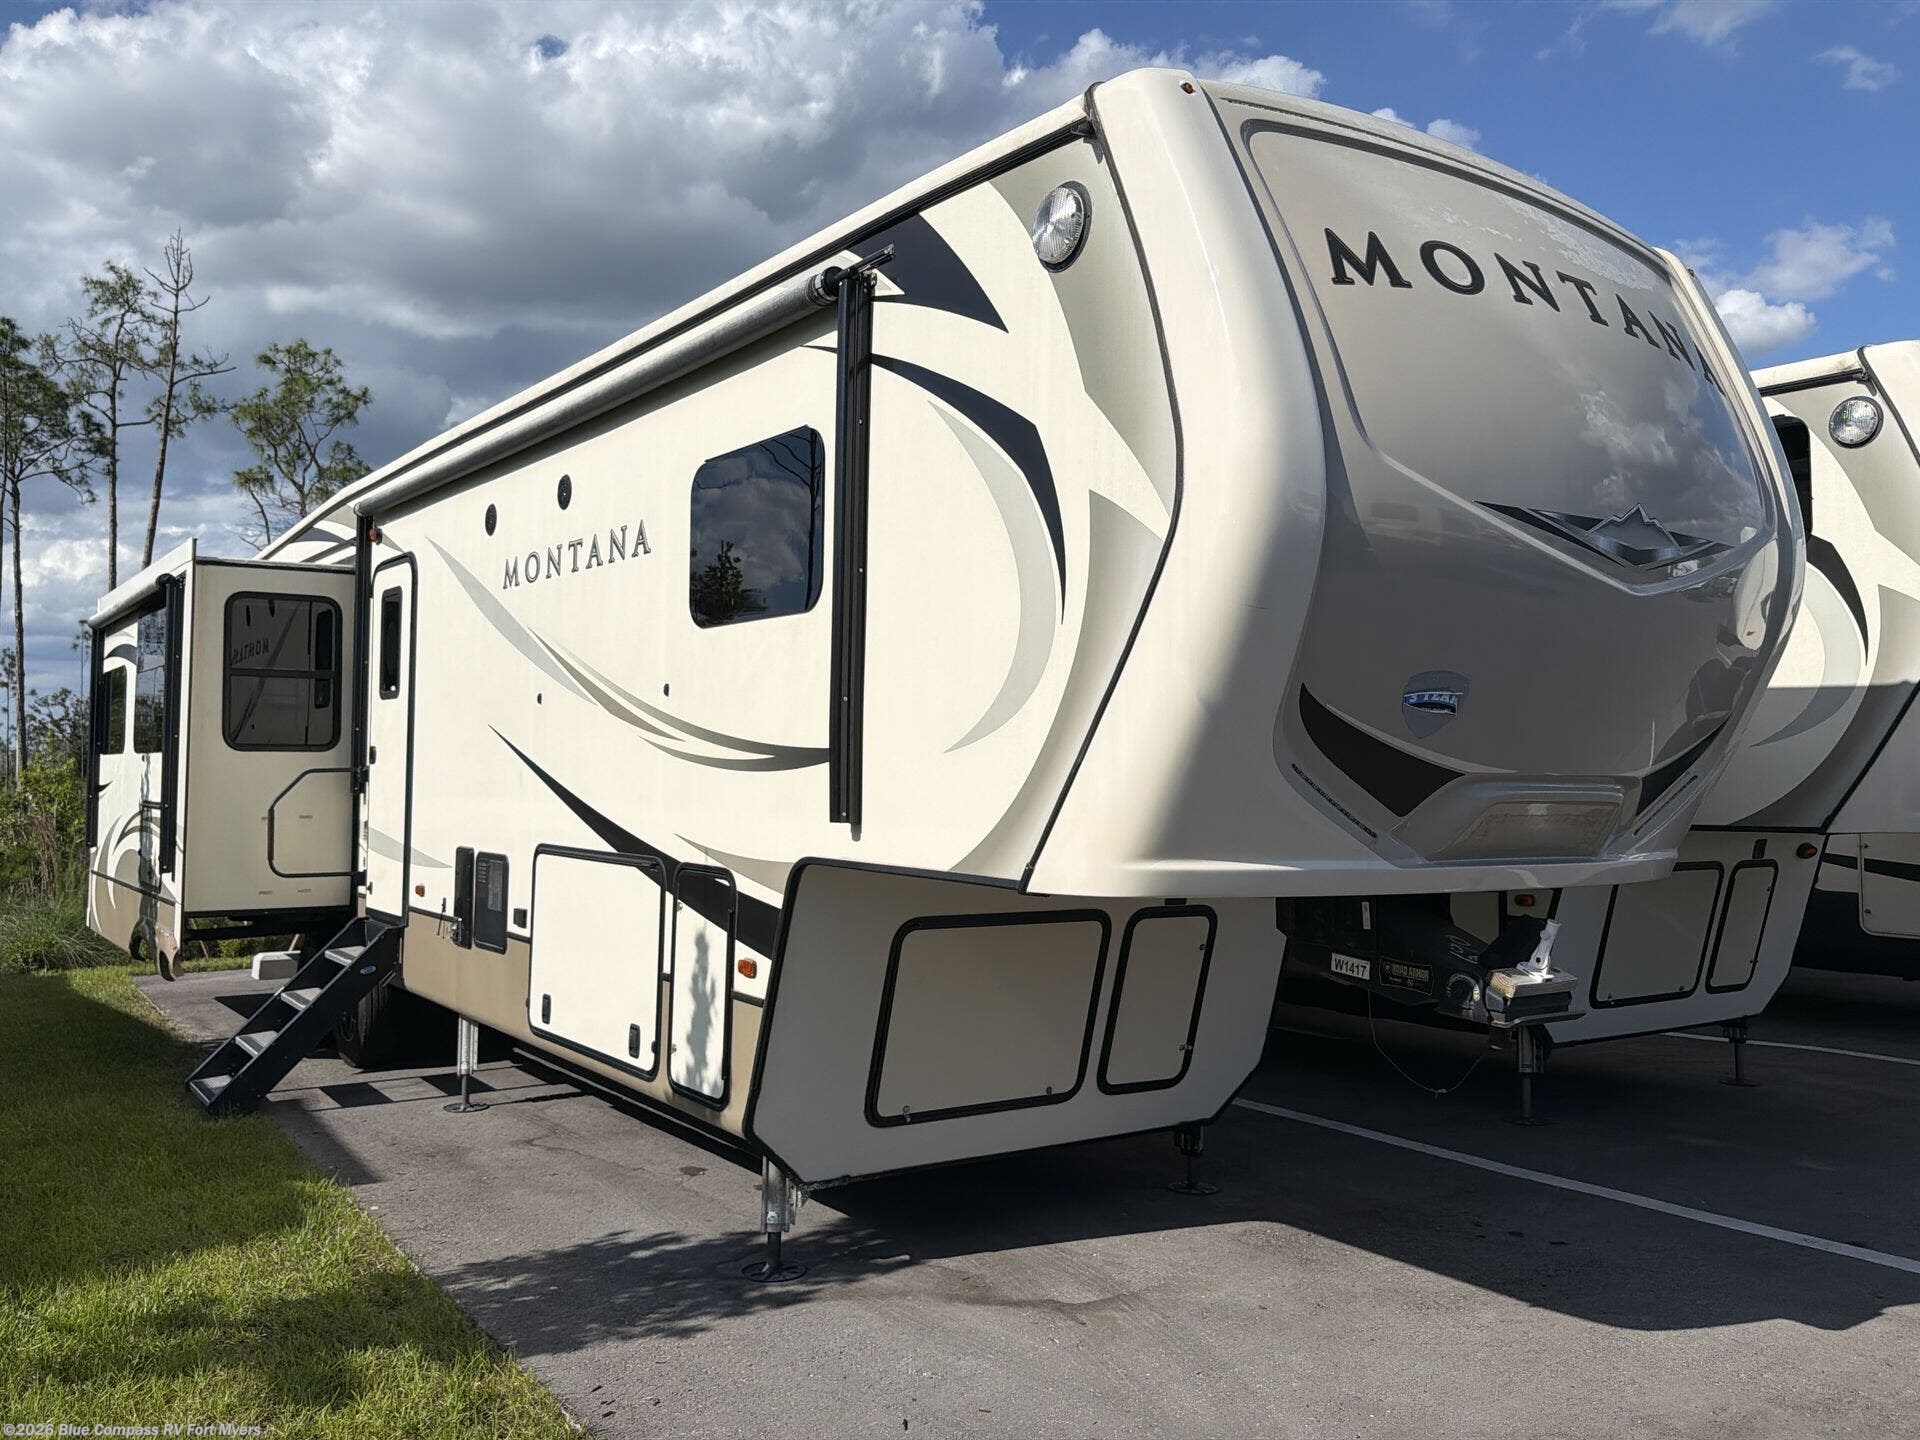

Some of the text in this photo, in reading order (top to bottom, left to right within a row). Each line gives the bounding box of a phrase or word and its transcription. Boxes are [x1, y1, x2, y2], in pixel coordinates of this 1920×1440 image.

[1324, 227, 1726, 397] MONTANA
[503, 519, 651, 589] MONTANA
[1334, 957, 1367, 977] W1417
